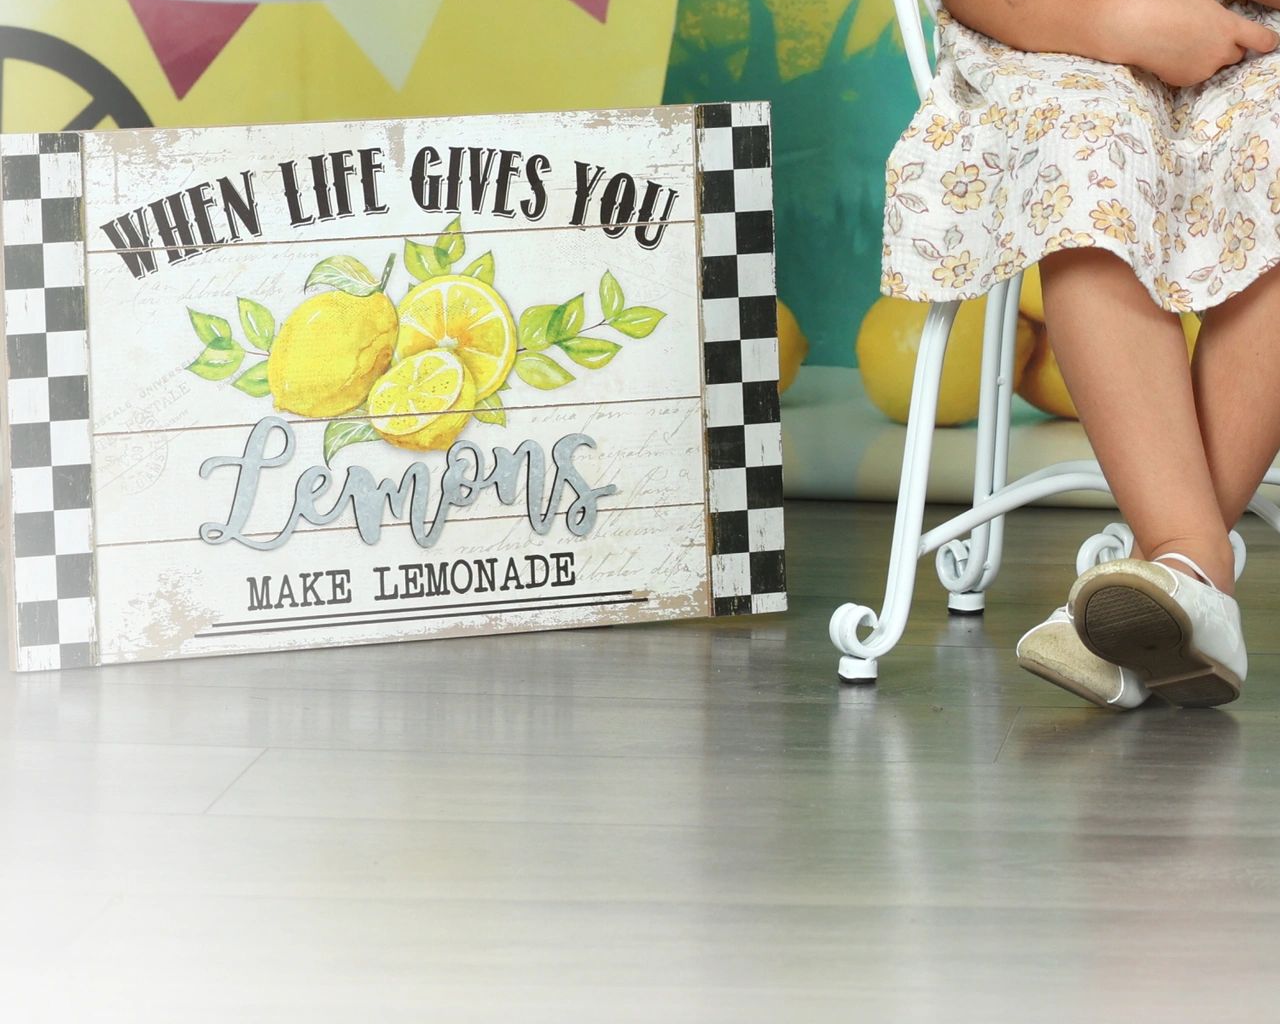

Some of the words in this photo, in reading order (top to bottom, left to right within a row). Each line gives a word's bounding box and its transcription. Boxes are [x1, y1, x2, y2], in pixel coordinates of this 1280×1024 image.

[98, 170, 264, 280] WHEN
[278, 147, 391, 229] LIFE
[410, 146, 551, 217] GIVES
[567, 160, 680, 251] YOU
[199, 416, 618, 553] Lemons
[246, 569, 354, 612] MAKE
[372, 552, 577, 599] LEMONADE
